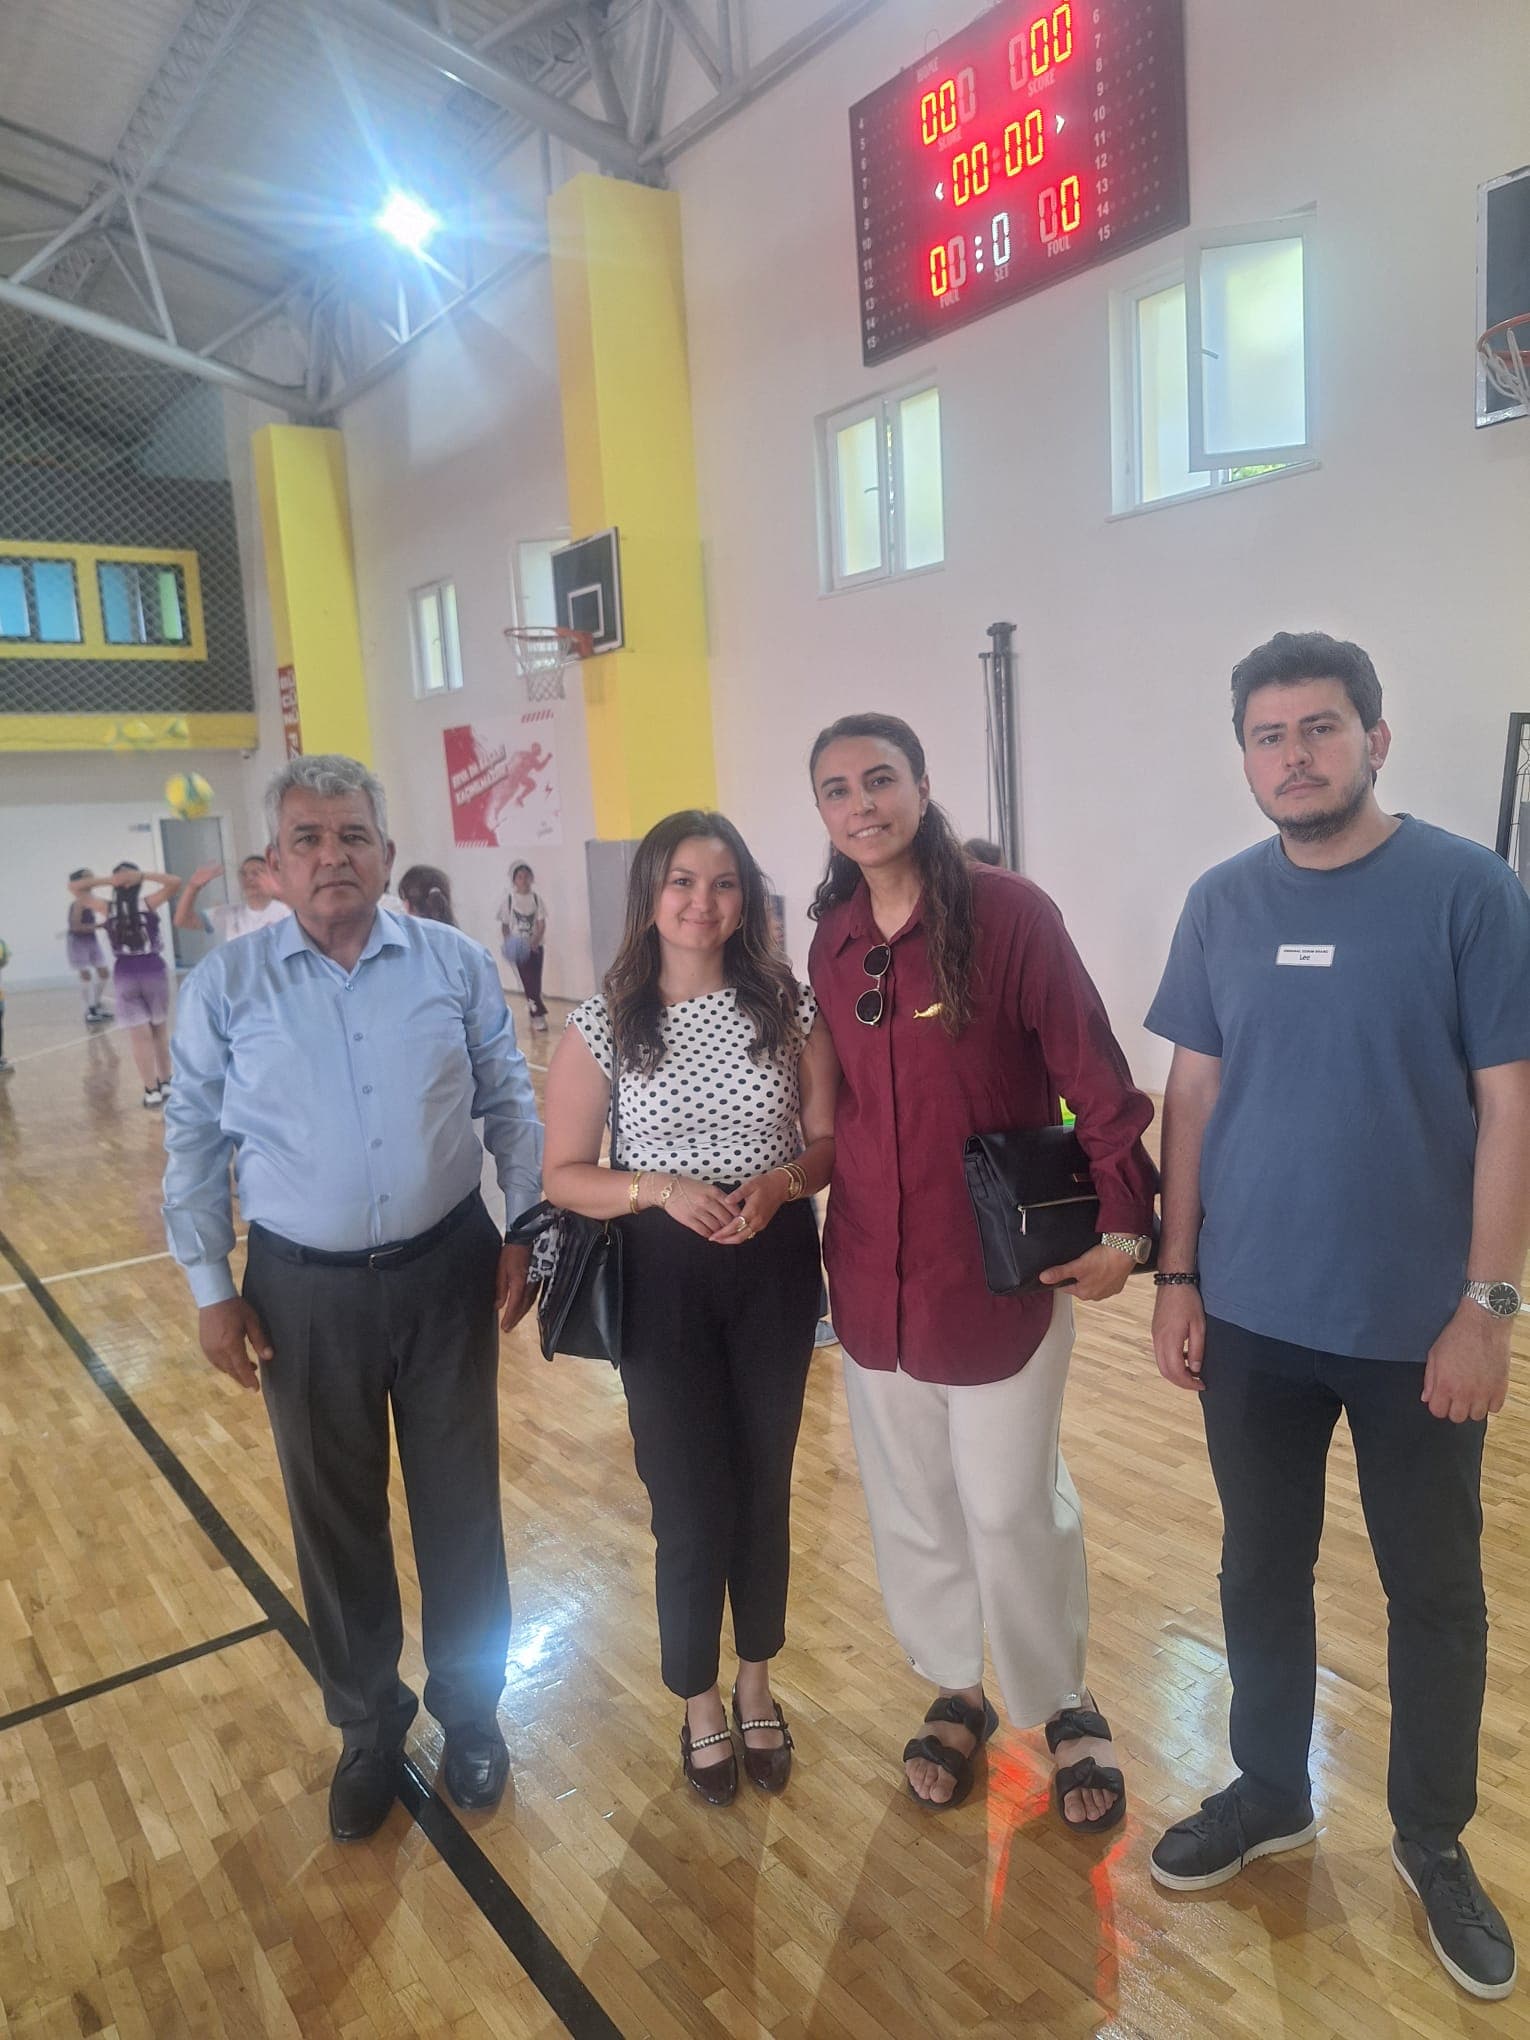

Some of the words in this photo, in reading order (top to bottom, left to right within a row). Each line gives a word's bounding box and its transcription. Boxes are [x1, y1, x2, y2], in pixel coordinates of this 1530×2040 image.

[1093, 8, 1099, 24] 6
[1094, 33, 1101, 48] 7
[1096, 57, 1102, 72] 8
[1027, 67, 1056, 97] SCORE
[1097, 81, 1104, 97] 9
[1093, 105, 1106, 123] 10
[1094, 130, 1106, 147] 11
[1095, 153, 1107, 170] 12
[1096, 177, 1109, 194] 13
[1096, 201, 1109, 218] 14
[1098, 224, 1111, 242] 15
[1047, 236, 1071, 257] FOUL
[994, 264, 1009, 282] SET
